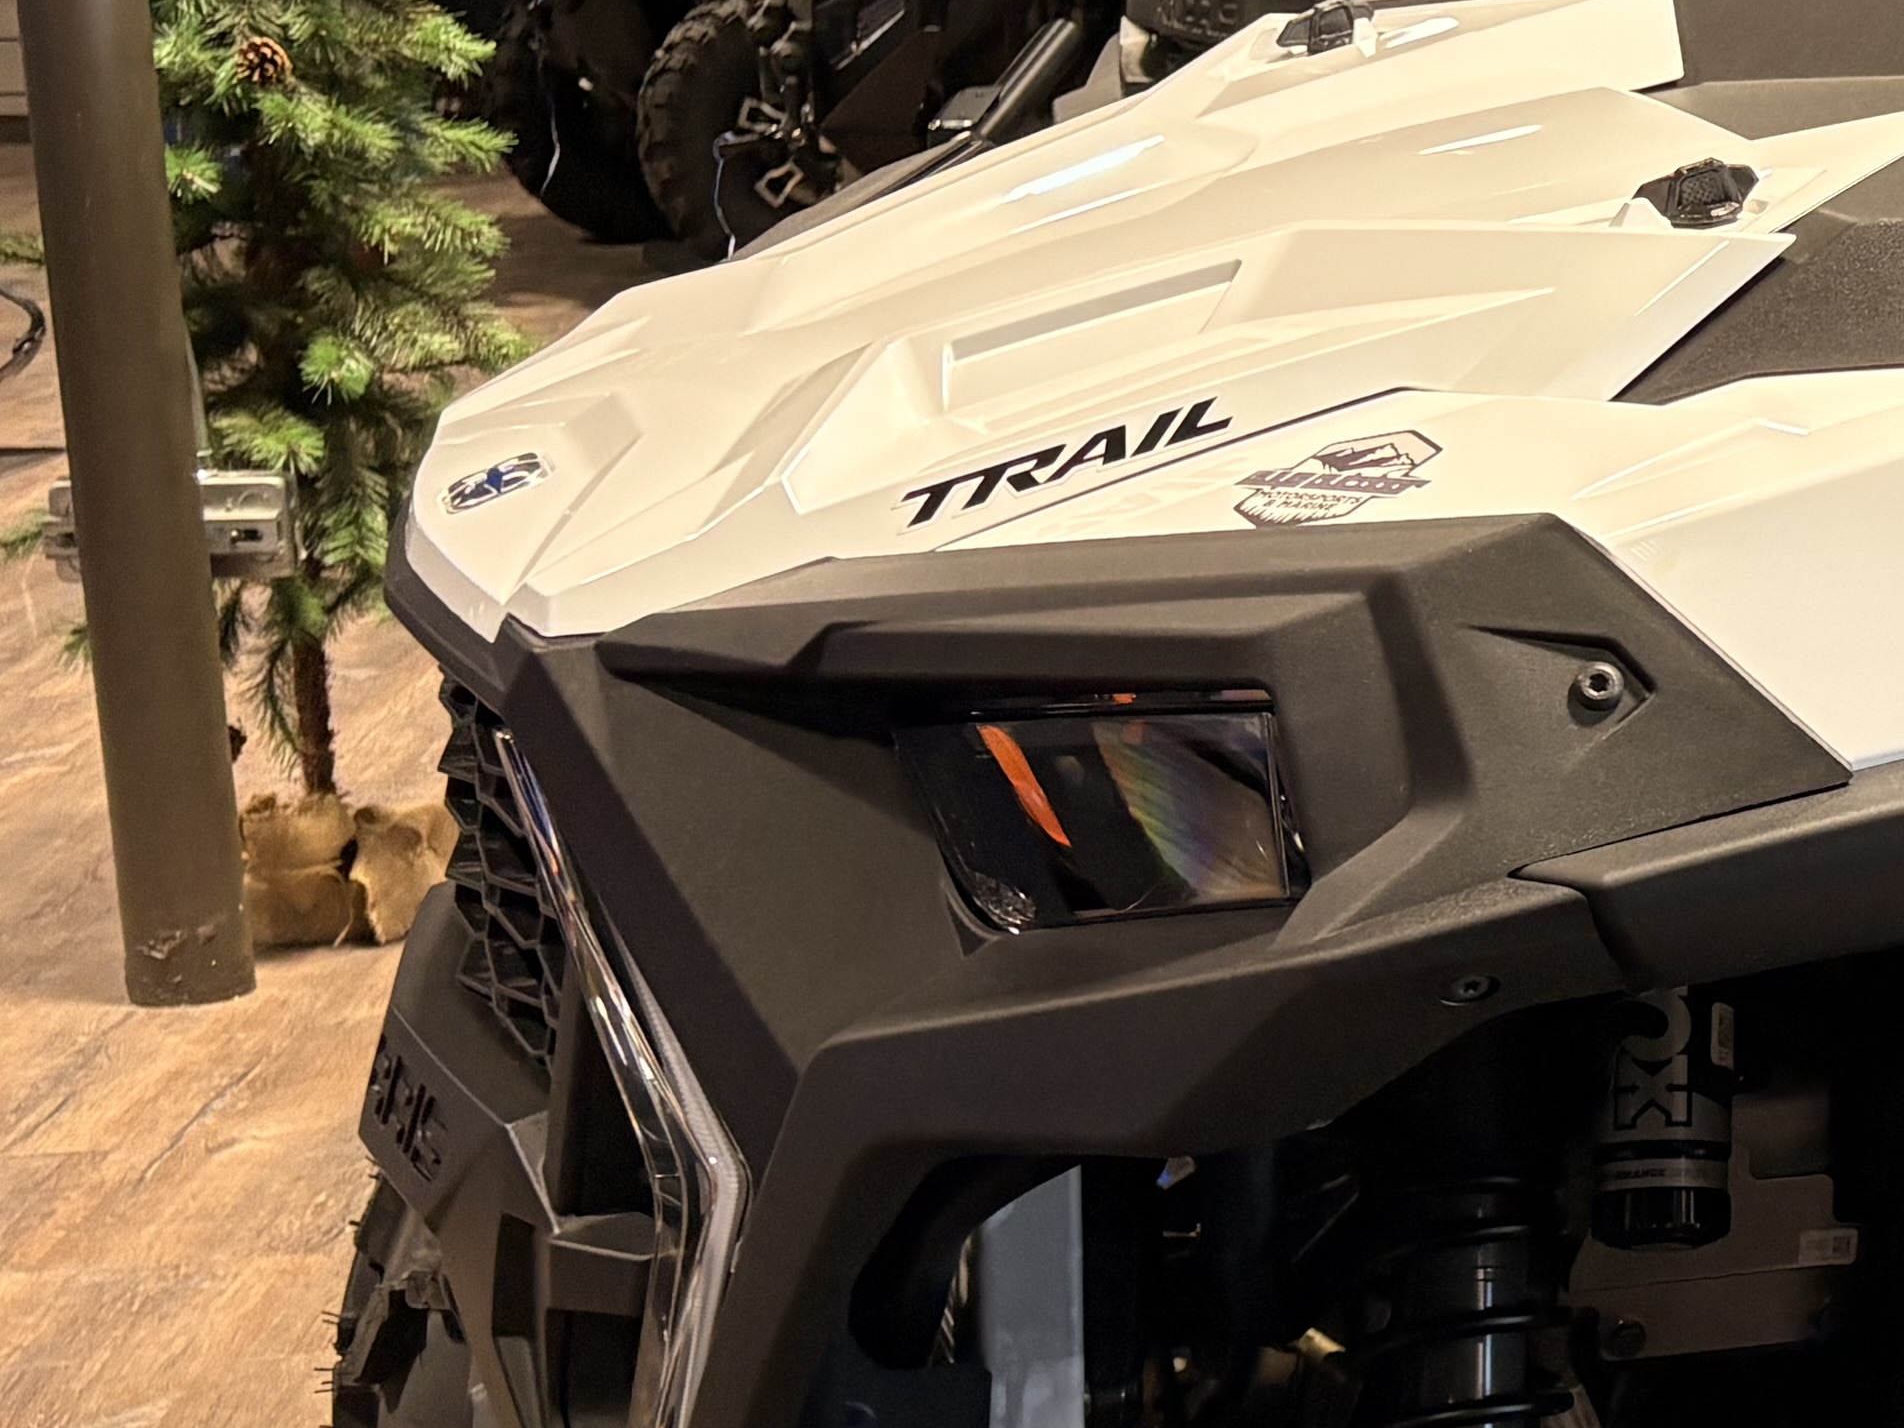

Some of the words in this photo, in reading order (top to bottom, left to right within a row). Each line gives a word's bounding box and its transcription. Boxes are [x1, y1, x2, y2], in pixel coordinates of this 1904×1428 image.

[901, 396, 1233, 528] TRAIL
[1256, 490, 1363, 504] MOTORSPORTS
[1277, 501, 1339, 511] MARINE
